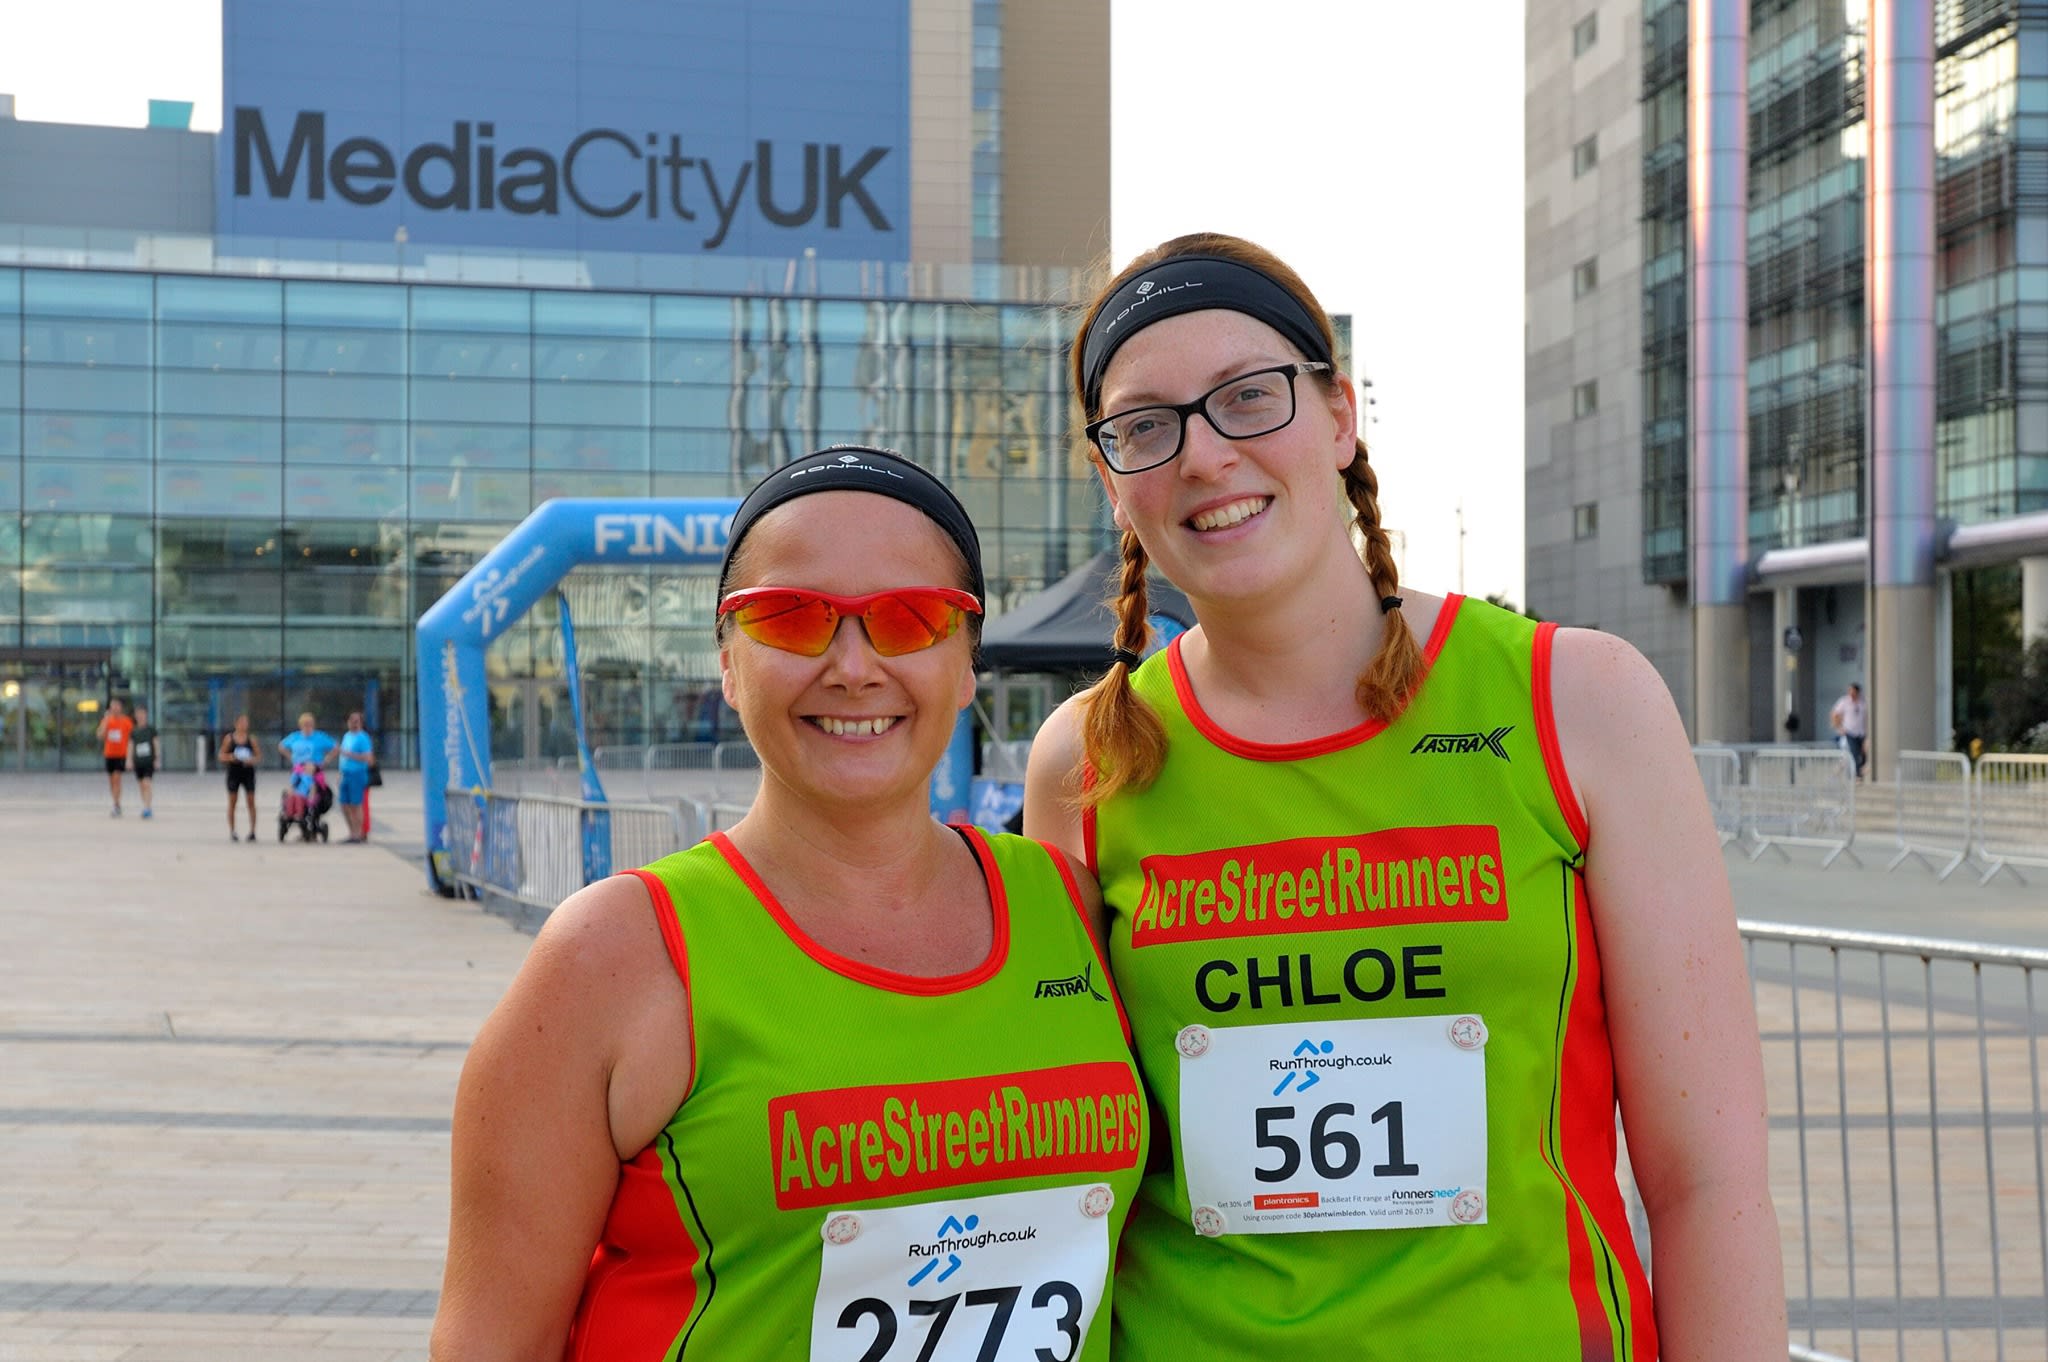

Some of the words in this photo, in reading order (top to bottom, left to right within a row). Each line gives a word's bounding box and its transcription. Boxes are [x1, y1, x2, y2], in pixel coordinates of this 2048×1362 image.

[234, 105, 893, 249] MediaCityUK
[1410, 725, 1516, 763] FASTRAX
[1134, 846, 1501, 933] AcreStreetRunners
[1195, 945, 1446, 1012] CHLOE
[1269, 1053, 1392, 1071] RunThrough.co.uk
[780, 1086, 1141, 1193] AcreStreetRunners
[1255, 1101, 1419, 1182] 561
[1263, 1196, 1310, 1206] plantronics
[1363, 1195, 1382, 1203] range
[1369, 1208, 1386, 1216] Valid
[1388, 1207, 1403, 1215] until
[1404, 1207, 1434, 1215] 26.07.19
[908, 1226, 1037, 1258] RunThrough.co.uk
[836, 1280, 1083, 1362] 2773
